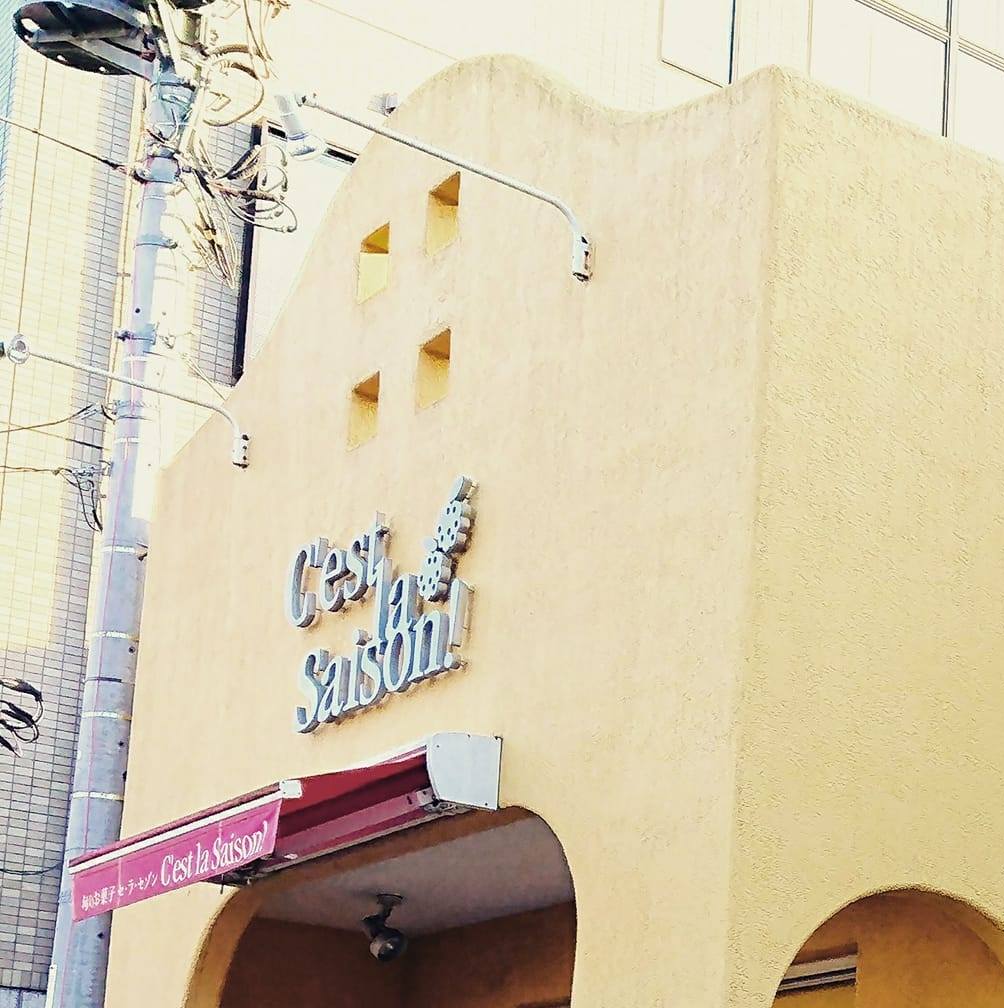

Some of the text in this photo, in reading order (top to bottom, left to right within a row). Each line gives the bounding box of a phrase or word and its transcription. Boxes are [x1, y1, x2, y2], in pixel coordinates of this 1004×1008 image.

[286, 510, 390, 628] C'est
[375, 557, 419, 650] la
[161, 851, 193, 886] C'est
[195, 842, 209, 875] la
[211, 820, 268, 870] Saison!
